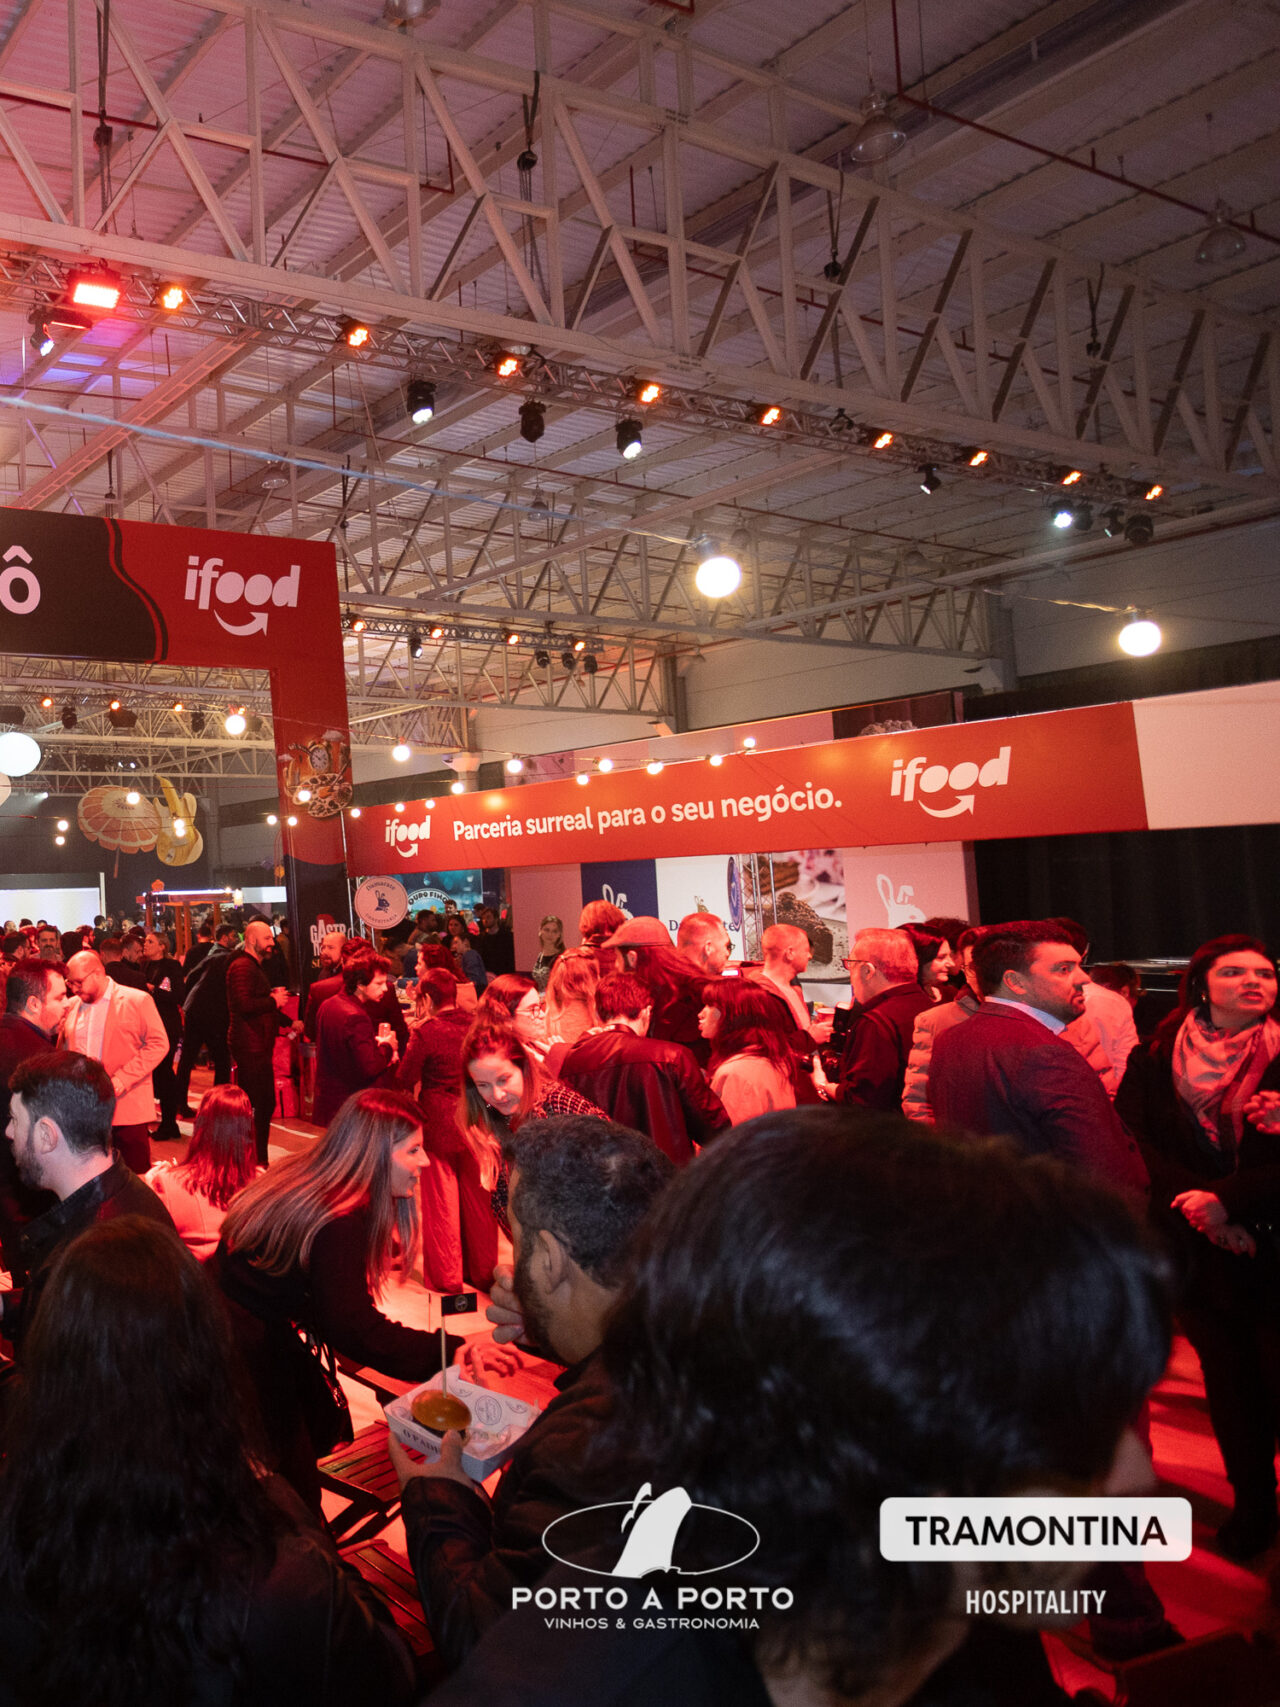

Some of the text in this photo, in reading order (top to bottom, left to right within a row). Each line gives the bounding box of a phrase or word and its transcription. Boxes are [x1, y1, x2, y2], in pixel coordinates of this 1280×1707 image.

[184, 555, 301, 611] ifood
[890, 746, 1011, 802] ifood
[385, 814, 431, 847] ifood
[453, 782, 842, 841] Parceria surreal para o seu negócio.
[408, 891, 428, 905] OURO
